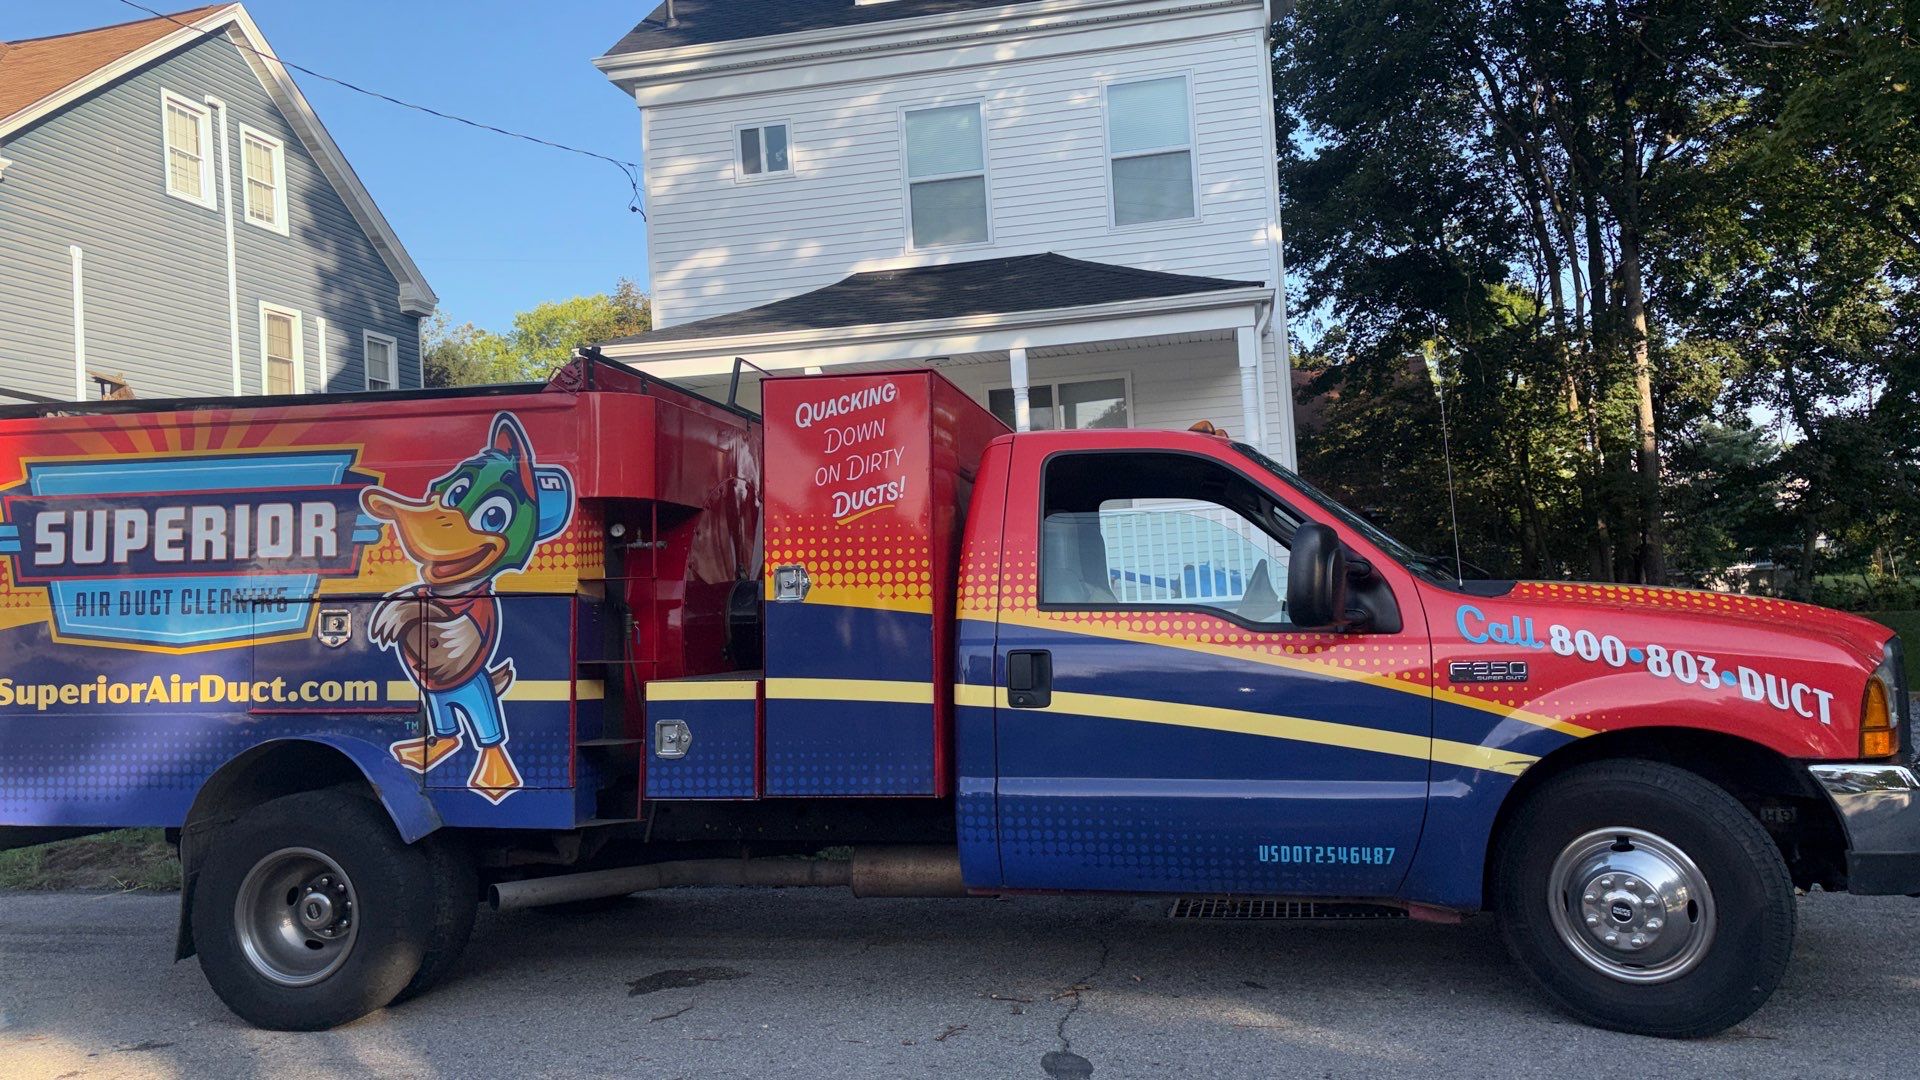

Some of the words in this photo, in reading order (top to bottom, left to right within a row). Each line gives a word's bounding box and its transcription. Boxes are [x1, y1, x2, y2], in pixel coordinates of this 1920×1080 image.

[794, 382, 897, 429] QUACKING
[823, 417, 886, 454] DOWN
[815, 462, 841, 487] ON
[845, 445, 905, 481] DIRTY
[831, 475, 906, 518] DUCTS!
[34, 501, 337, 566] SUPERIOR
[75, 591, 111, 617] AIR
[119, 588, 174, 616] DUCT
[180, 586, 289, 615] CLEANING
[1456, 604, 1545, 649] Call
[0, 673, 378, 711] SuperiorAirDuct.com
[1258, 845, 1396, 865] USDOT2546487
